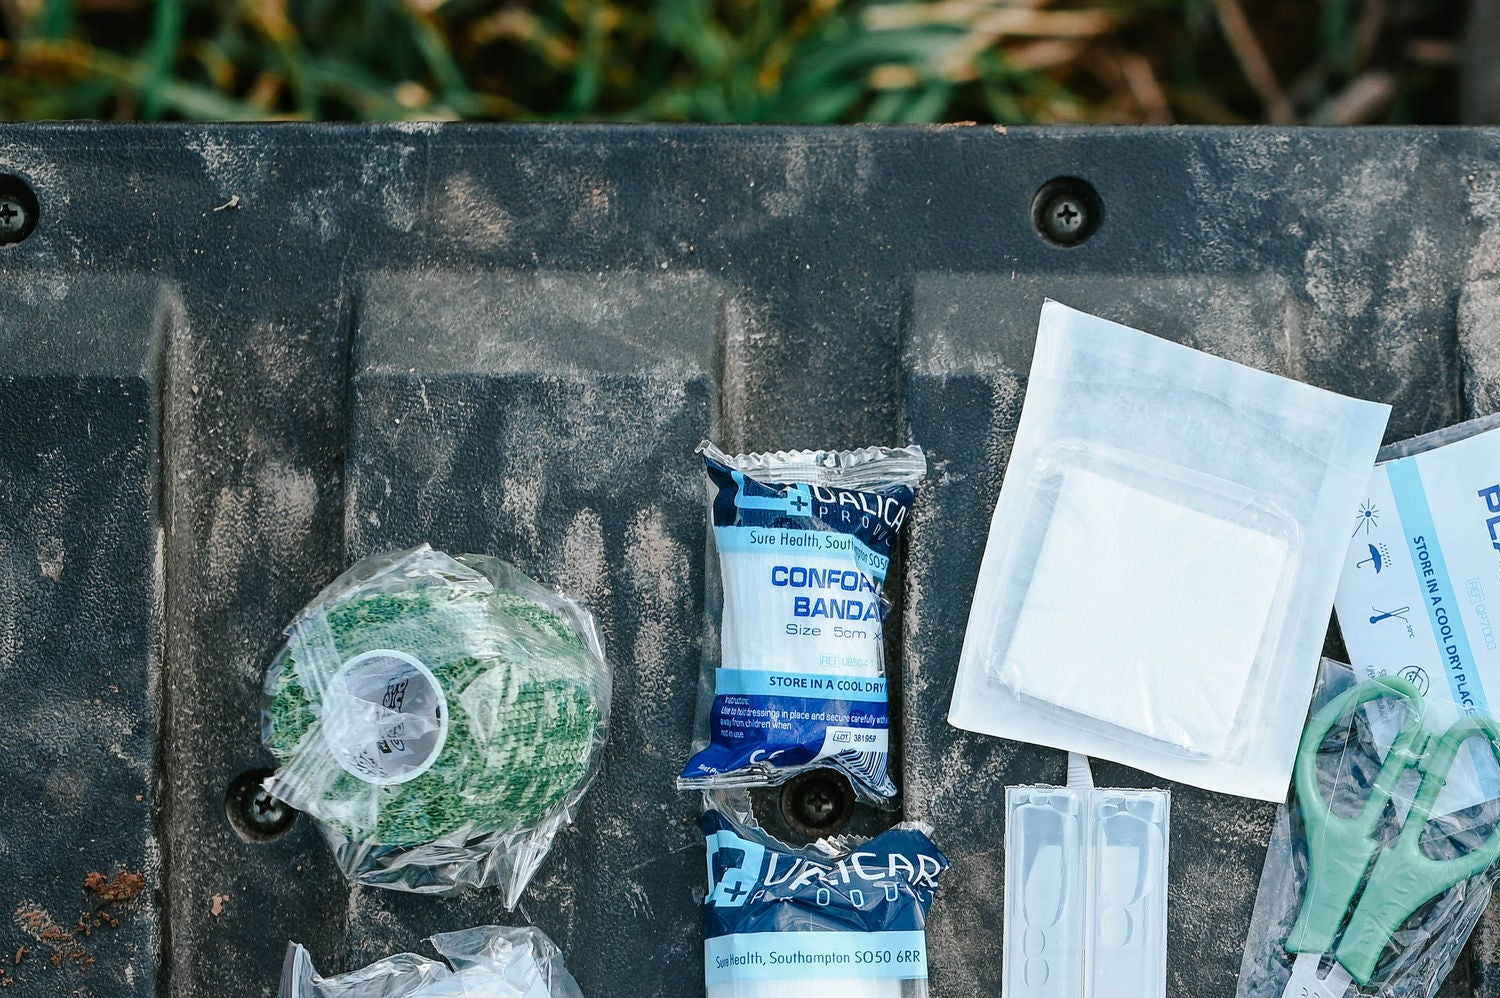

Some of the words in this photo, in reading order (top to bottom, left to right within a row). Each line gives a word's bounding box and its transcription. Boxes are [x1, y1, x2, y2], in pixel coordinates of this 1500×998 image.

[750, 531, 776, 545] Sure
[781, 532, 822, 550] Health,
[1413, 535, 1435, 578] STORE
[1425, 578, 1440, 594] IN
[1430, 596, 1442, 606] A
[786, 623, 821, 637] Size
[834, 626, 867, 639] 5cm
[1434, 607, 1454, 644] COOL
[1445, 644, 1463, 670] DRY
[769, 677, 807, 688] STORE
[811, 679, 823, 690] IN
[826, 680, 834, 690] A
[837, 681, 863, 692] COOL
[866, 682, 884, 693] DRY
[745, 708, 780, 722] dressings
[782, 709, 788, 718] in
[789, 710, 809, 721] place
[811, 712, 824, 721] and
[826, 714, 850, 723] secure
[850, 715, 876, 726] carefully
[773, 721, 792, 730] when
[836, 733, 848, 741] LOT
[770, 951, 850, 966] Southampton
[896, 950, 920, 963] 6RR
